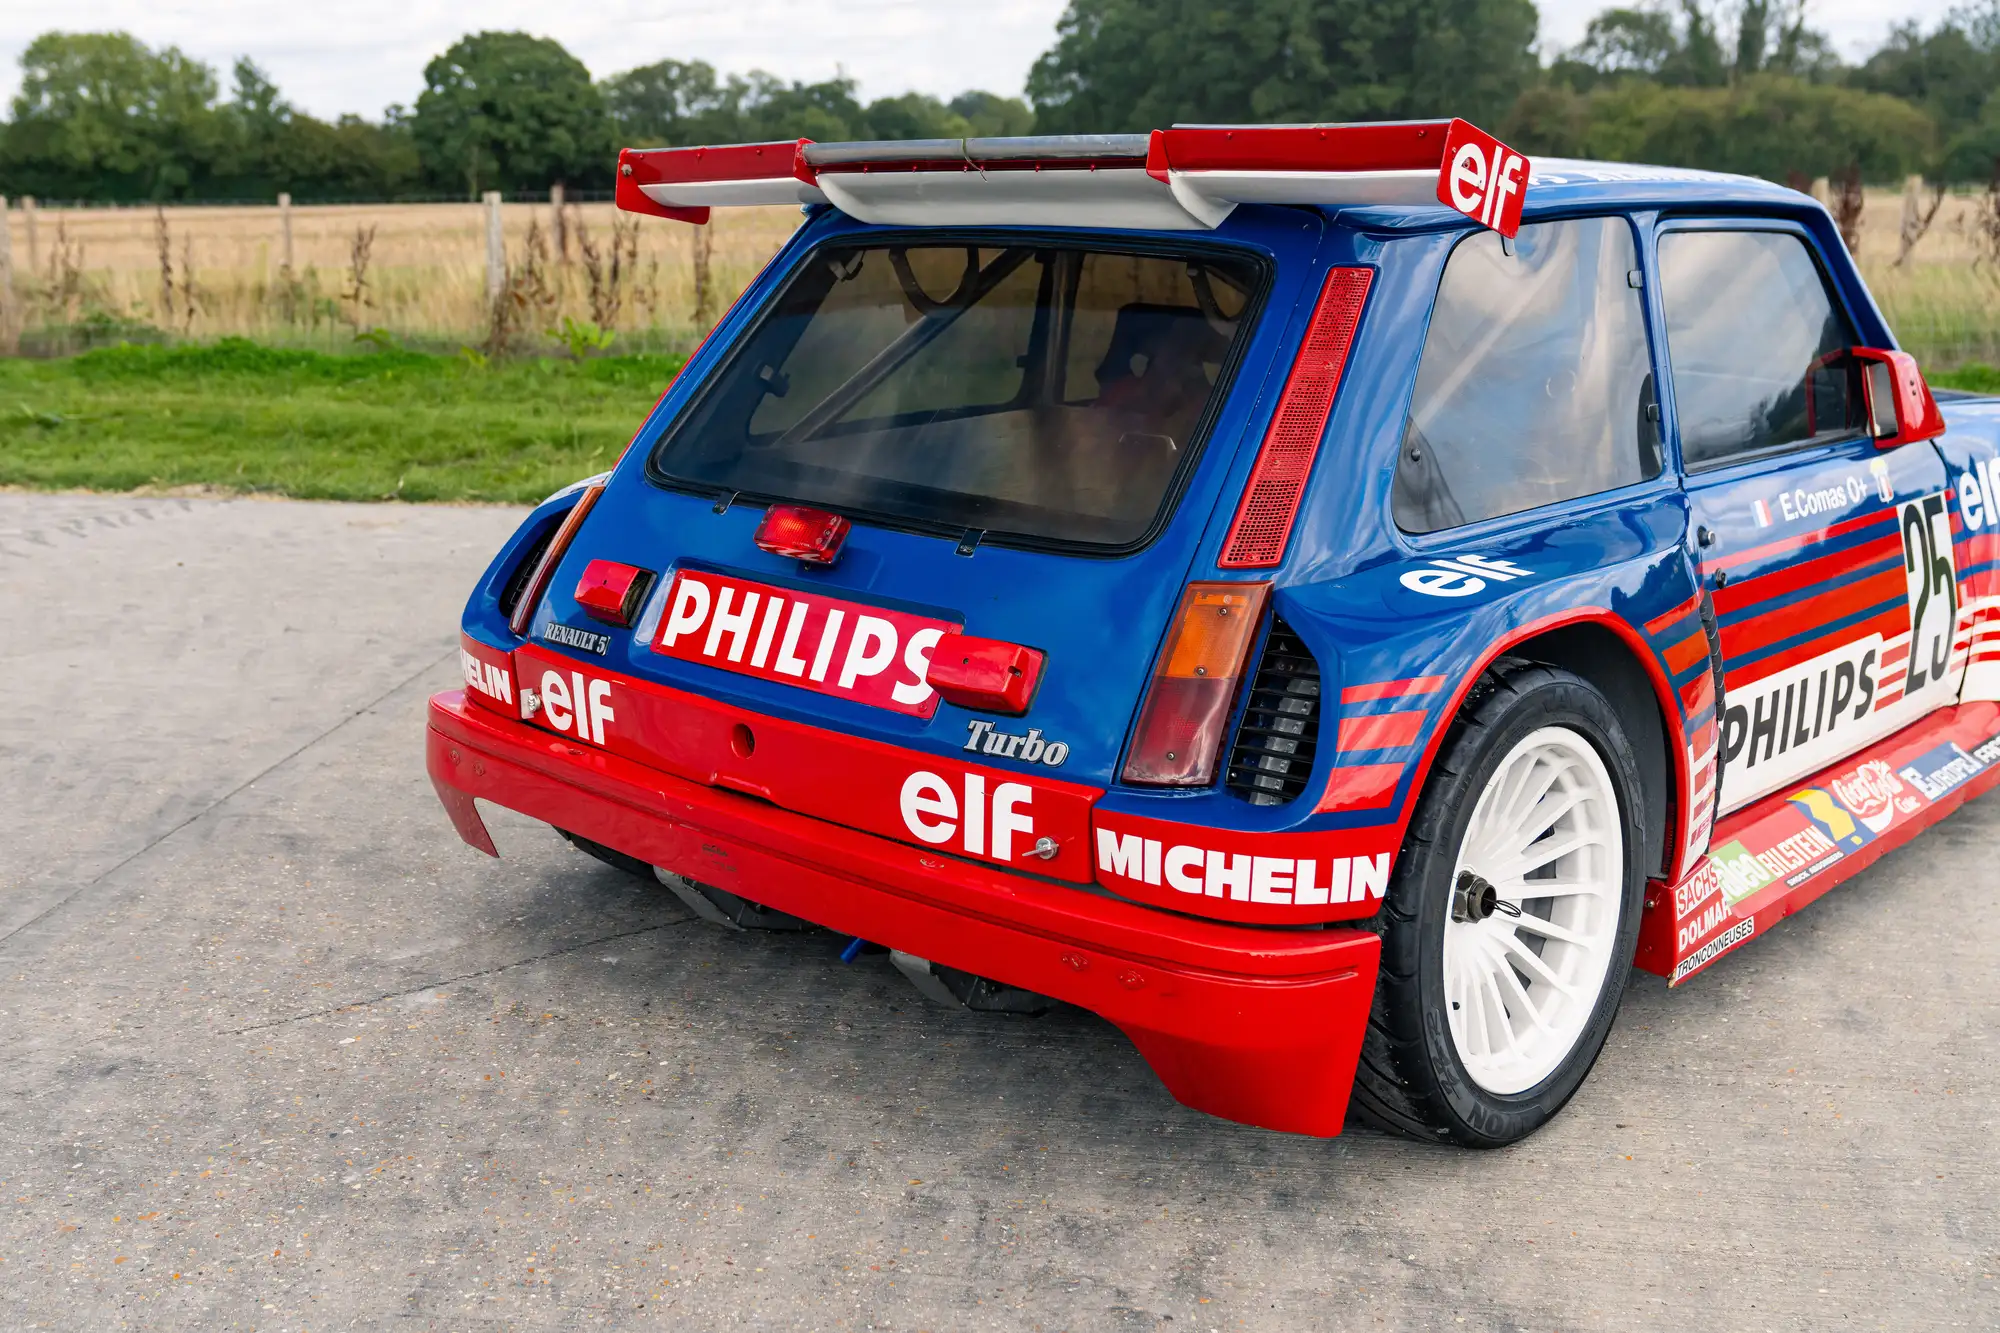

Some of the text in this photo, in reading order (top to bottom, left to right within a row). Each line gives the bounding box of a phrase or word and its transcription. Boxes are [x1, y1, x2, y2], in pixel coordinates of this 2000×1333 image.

[1450, 142, 1523, 230] elf
[1779, 485, 1848, 521] E.Comas
[1400, 554, 1536, 597] elf
[1903, 494, 1957, 697] 25
[544, 622, 607, 654] RENAULT 5
[662, 579, 945, 705] PHILIPS
[541, 670, 615, 746] elf
[1722, 648, 1876, 769] PHILIPS
[963, 720, 1069, 767] Turbo
[900, 771, 1033, 862] elf
[1096, 827, 1391, 905] MICHELIN
[1756, 825, 1836, 878] BILSTEIN
[1677, 863, 1720, 915] SACHS
[1677, 919, 1754, 979] TRONCONNEUSES
